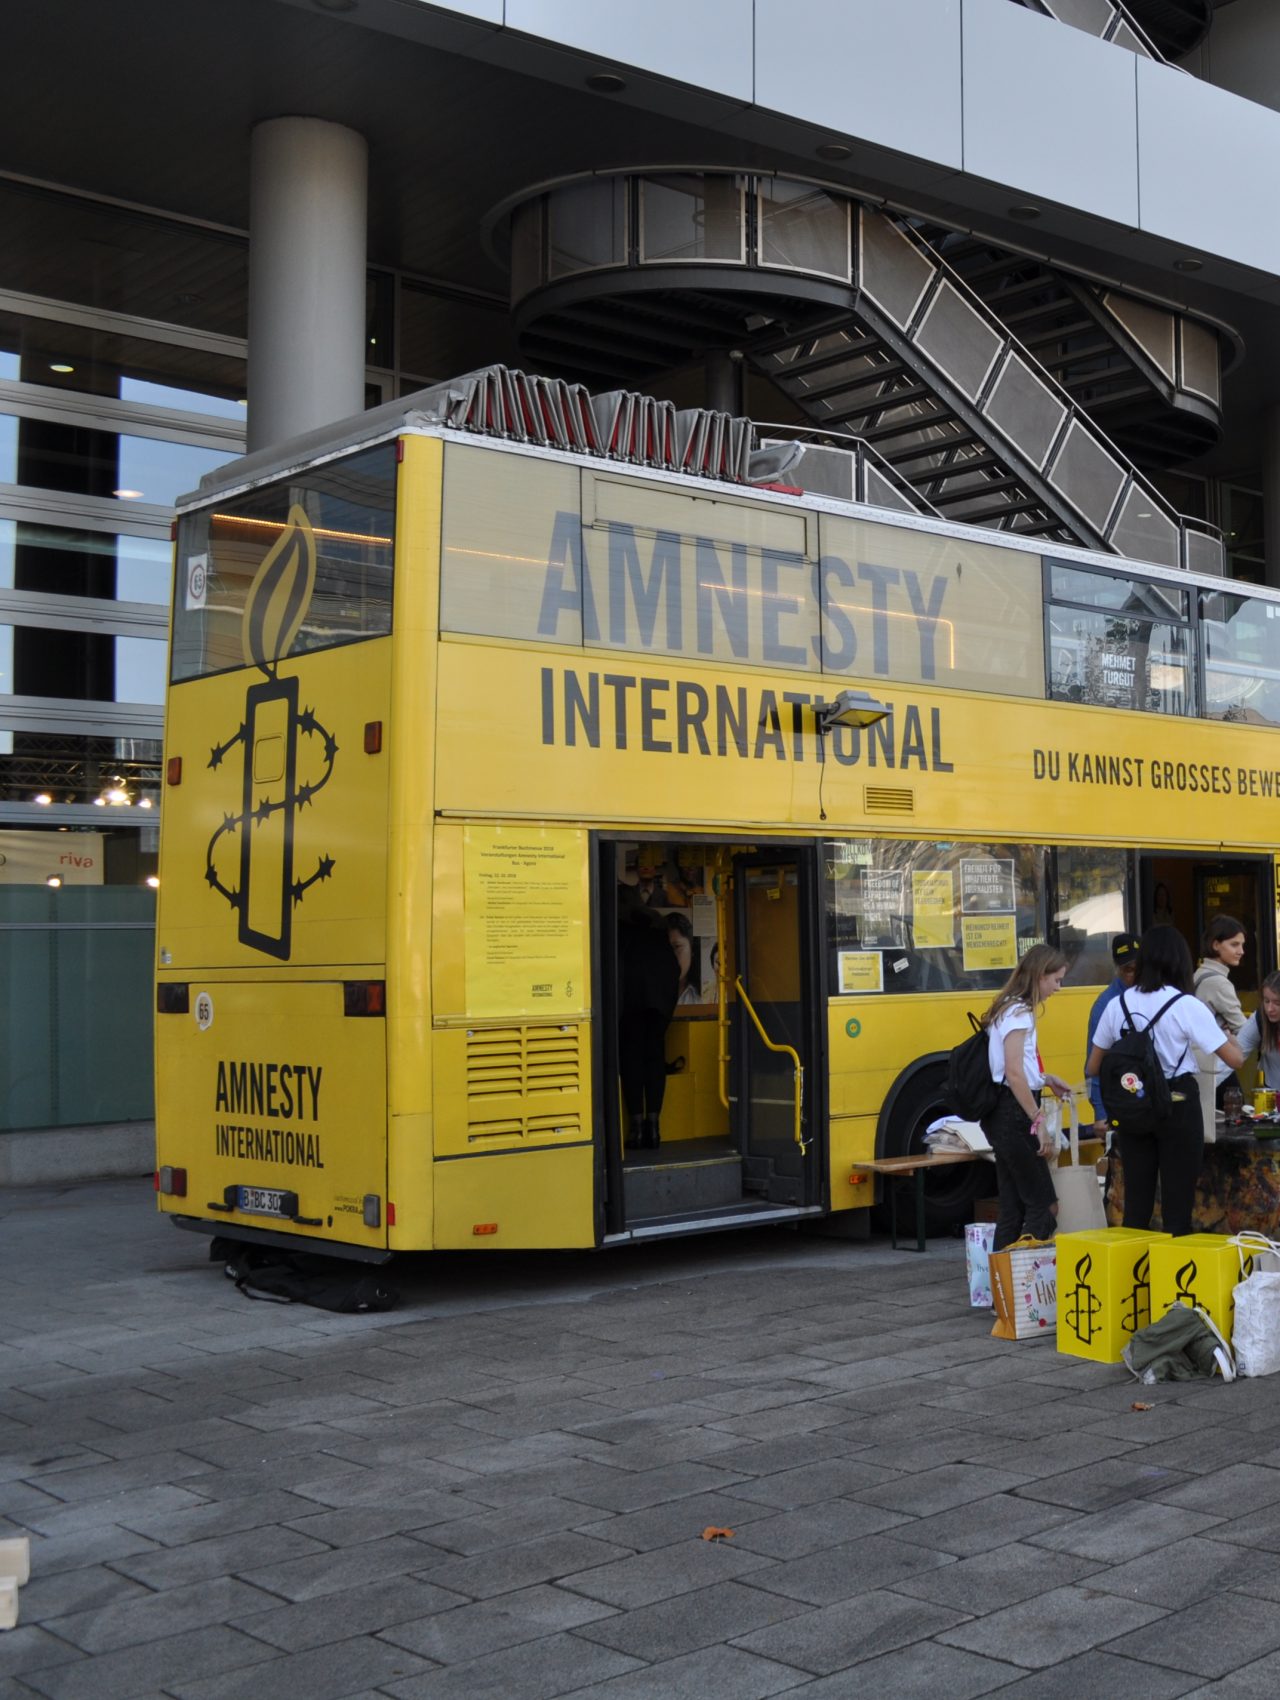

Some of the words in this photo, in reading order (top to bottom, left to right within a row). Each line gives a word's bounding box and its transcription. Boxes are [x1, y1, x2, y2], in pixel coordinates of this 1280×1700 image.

[537, 511, 949, 681] AMNESTY
[1101, 653, 1137, 671] MEHMET
[1103, 670, 1135, 687] TURGUT
[541, 666, 955, 775] INTERNATIONAL
[1033, 749, 1061, 781] DU
[1068, 752, 1145, 788] KANNST
[1151, 760, 1232, 795] GROSSES
[59, 852, 94, 868] riva
[215, 1060, 323, 1122] AMNESTY
[216, 1124, 325, 1169] INTERNATIONAL
